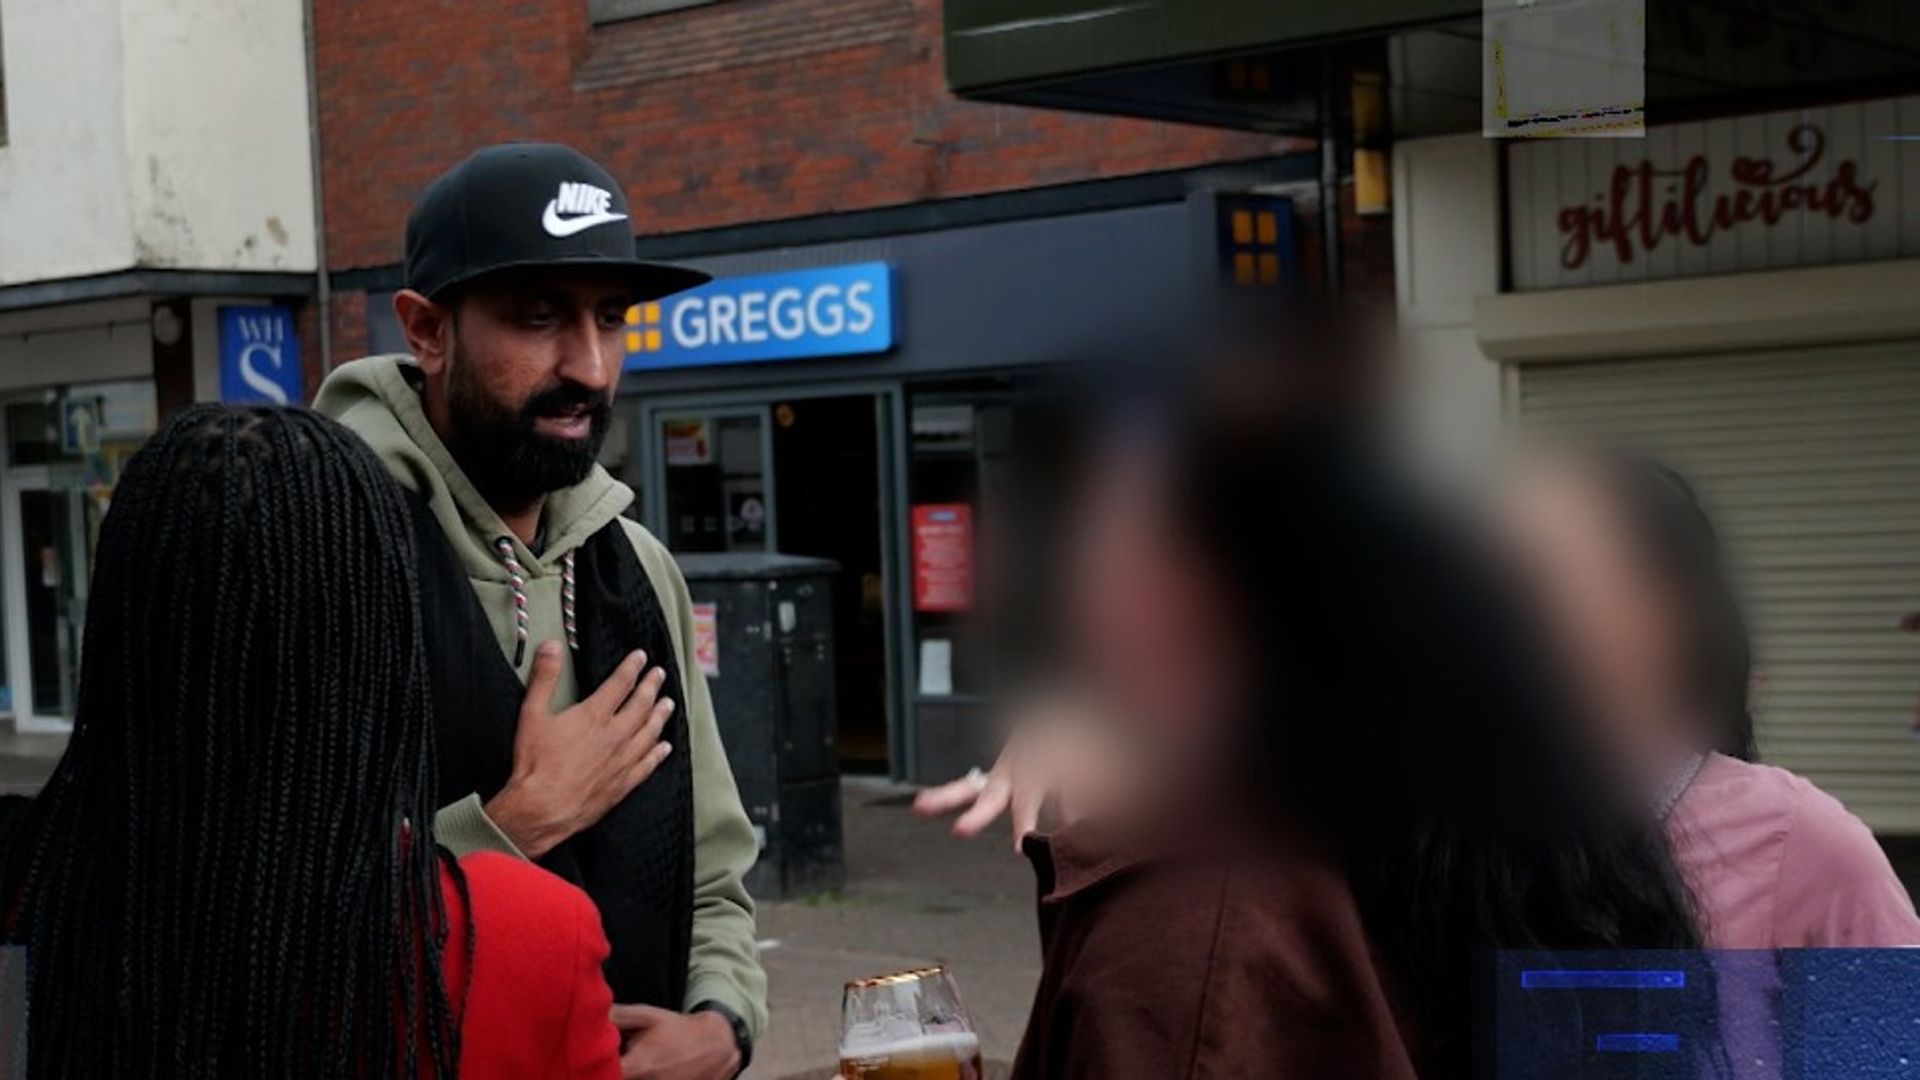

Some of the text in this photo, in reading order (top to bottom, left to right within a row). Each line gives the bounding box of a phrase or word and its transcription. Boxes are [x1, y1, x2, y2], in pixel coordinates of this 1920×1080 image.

[557, 182, 612, 213] NIKE
[238, 316, 284, 341] WH
[672, 281, 873, 348] GREGGS
